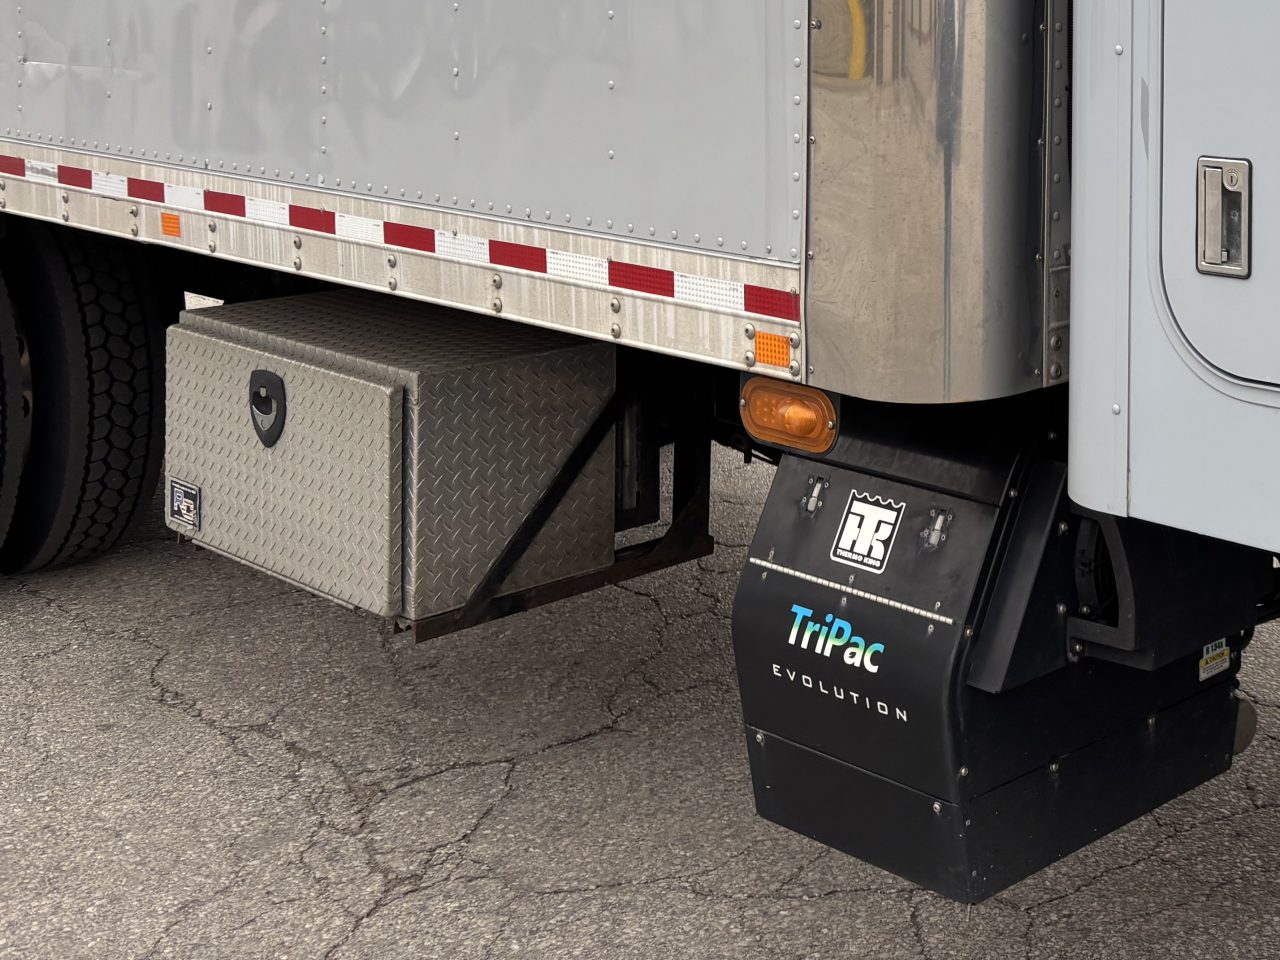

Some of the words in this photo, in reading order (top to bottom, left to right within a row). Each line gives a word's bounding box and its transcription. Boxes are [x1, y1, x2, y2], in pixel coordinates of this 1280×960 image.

[836, 549, 863, 562] THERMO
[863, 556, 881, 567] KING
[788, 604, 885, 673] TriPac
[772, 664, 907, 722] EVOLUTION
